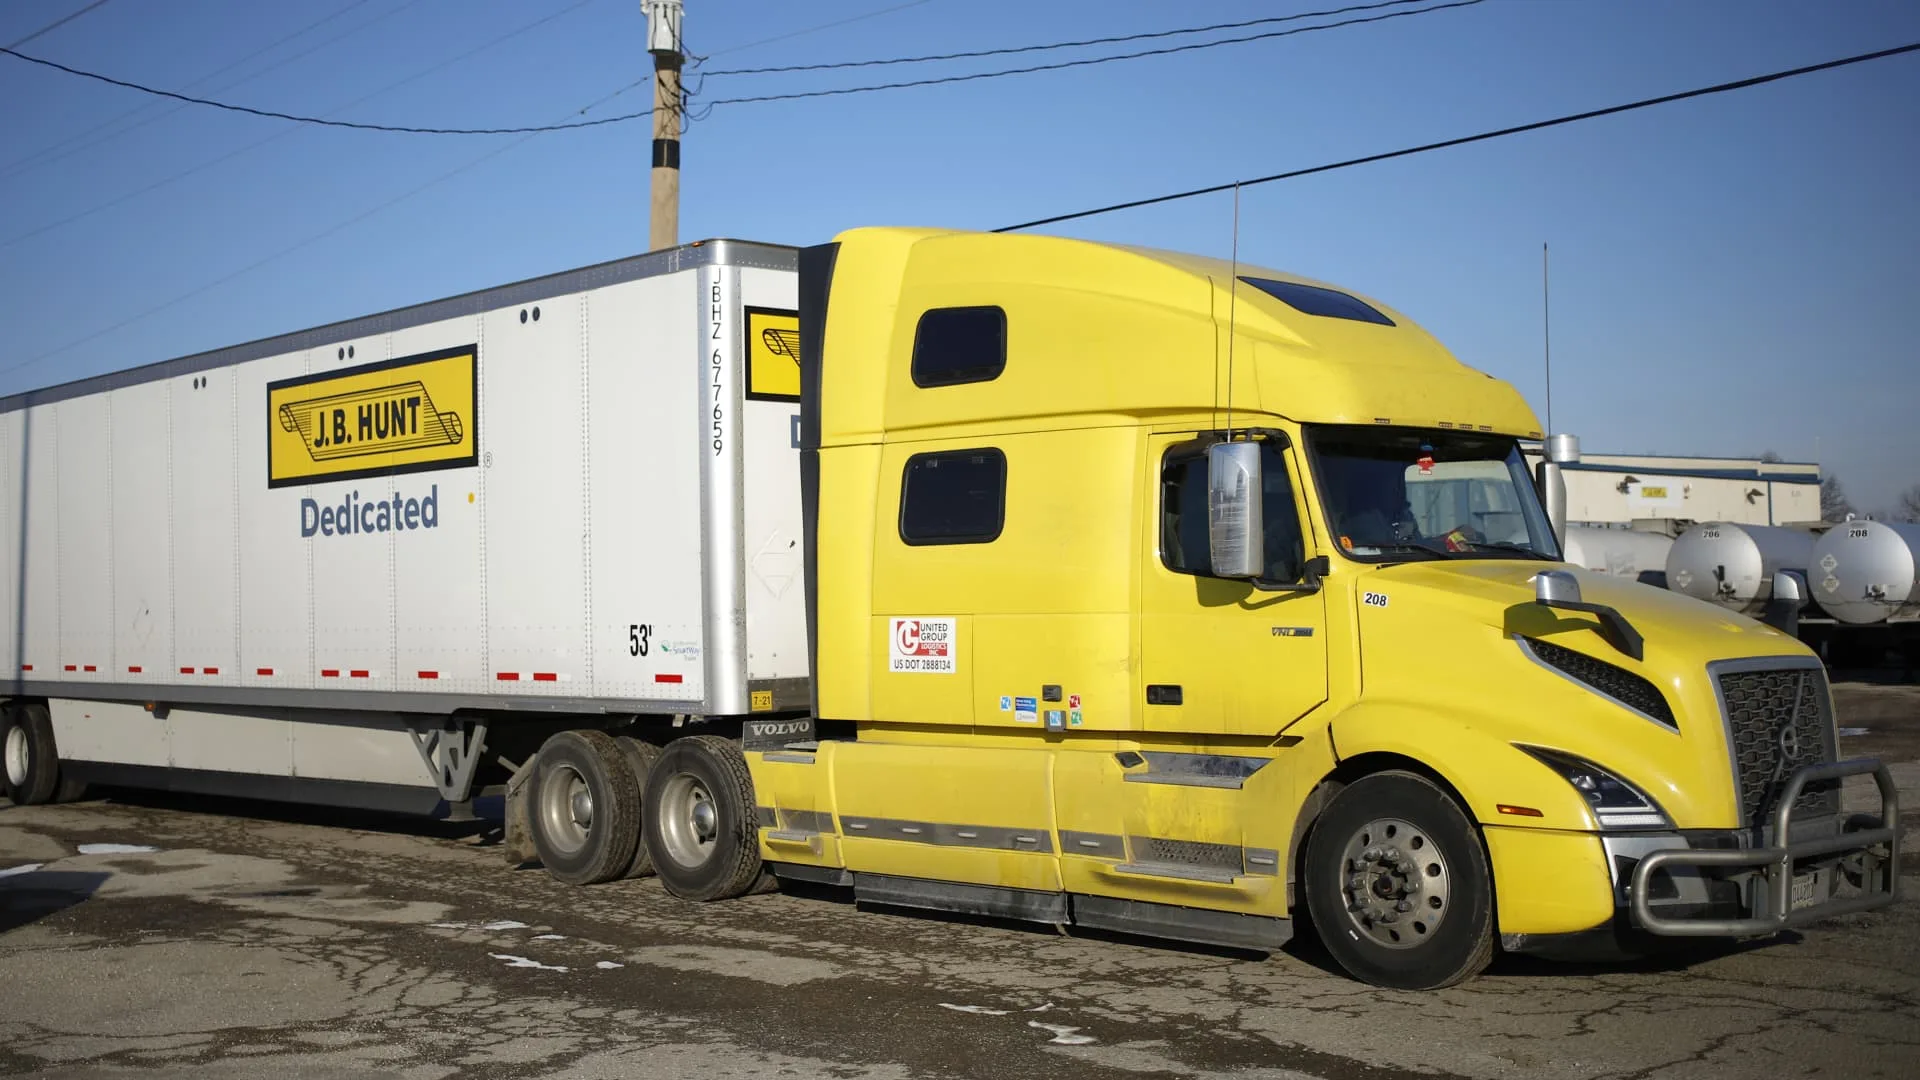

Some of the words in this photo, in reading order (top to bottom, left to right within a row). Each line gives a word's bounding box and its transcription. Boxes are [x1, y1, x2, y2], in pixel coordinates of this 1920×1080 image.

[712, 267, 722, 339] JBHZ
[712, 348, 723, 456] 677659
[358, 396, 421, 441] HUNT
[300, 484, 438, 538] Dedicated
[1849, 525, 1868, 537] 208
[1365, 592, 1387, 607] 208
[920, 623, 948, 632] UNITED
[630, 624, 652, 656] 53'
[920, 633, 947, 641] GROUP
[894, 659, 904, 669] US
[905, 659, 920, 669] DOT
[922, 660, 951, 670] 2888134
[753, 695, 771, 705] 7-21
[751, 721, 810, 736] VOLVO
